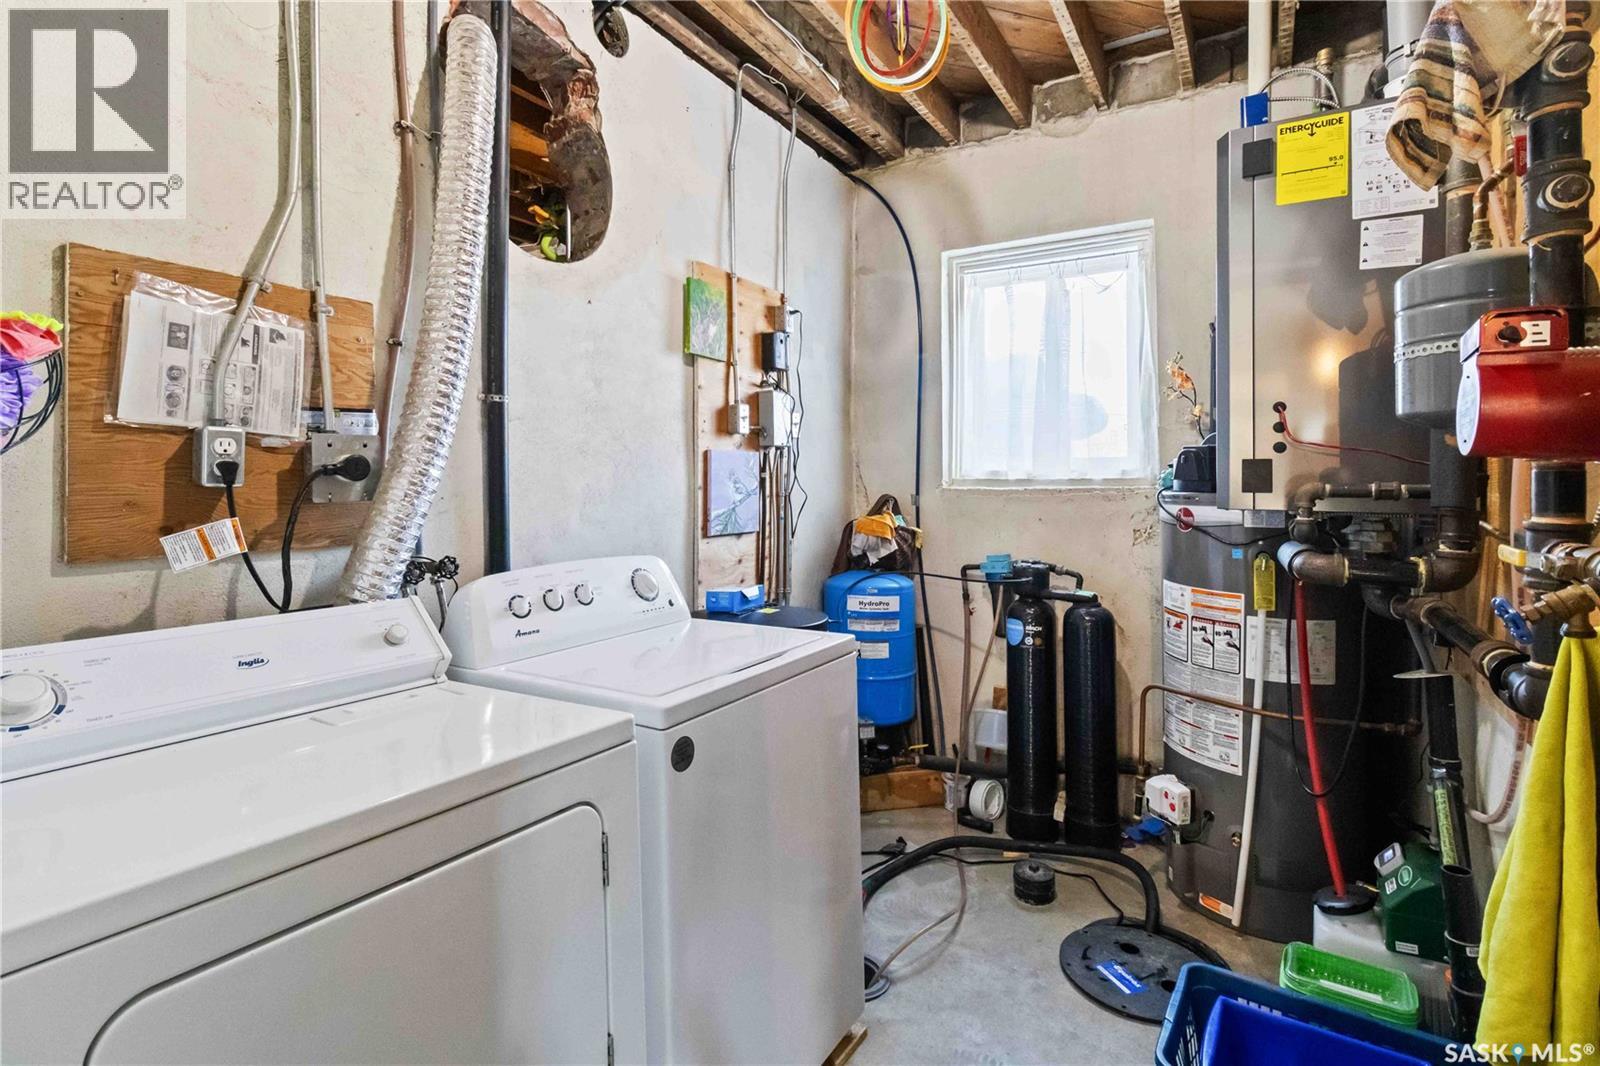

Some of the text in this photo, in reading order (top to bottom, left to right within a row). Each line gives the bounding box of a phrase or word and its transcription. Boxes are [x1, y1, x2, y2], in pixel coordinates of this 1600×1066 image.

[1280, 116, 1344, 136] ENERGYGUIDE
[858, 600, 890, 608] HydroPro
[515, 628, 540, 638] Amana
[237, 657, 265, 668] Inglis
